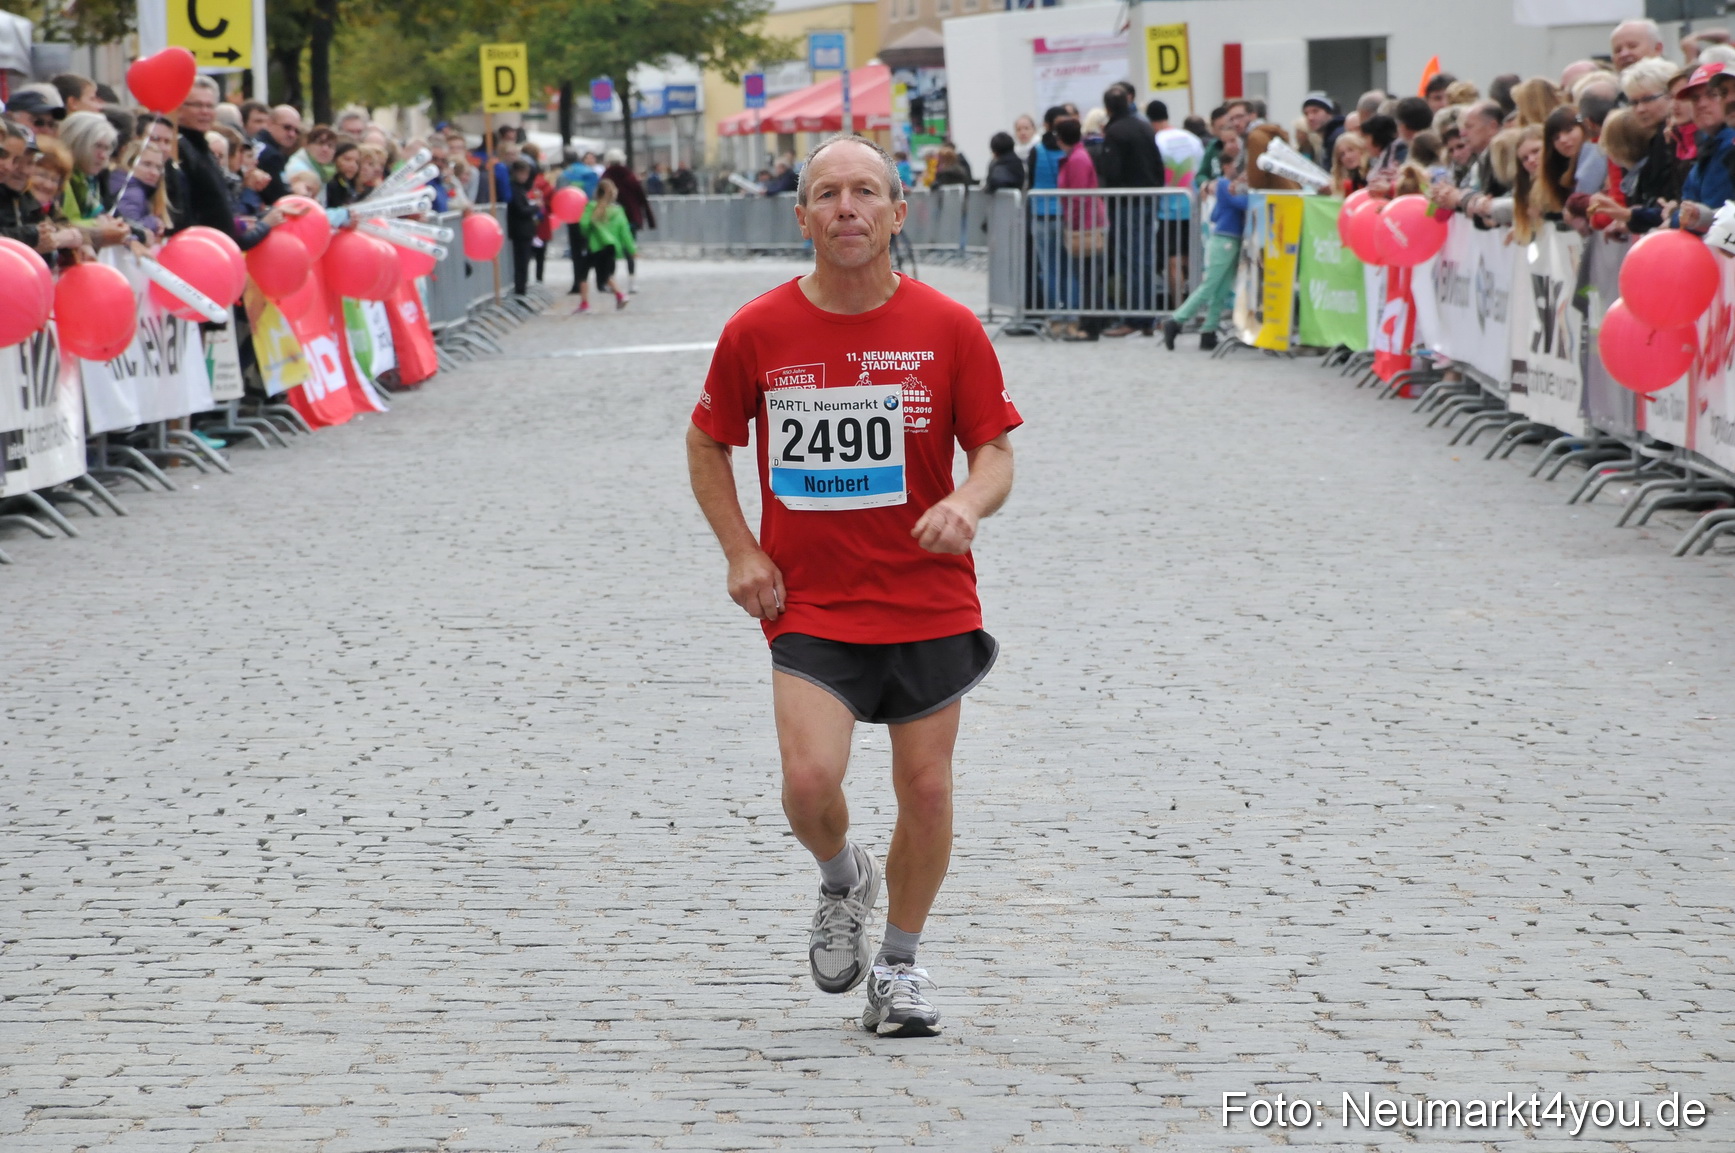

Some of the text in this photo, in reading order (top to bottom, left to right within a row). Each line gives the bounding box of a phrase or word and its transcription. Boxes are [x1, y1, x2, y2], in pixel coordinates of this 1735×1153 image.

[188, 0, 229, 38] C
[1158, 45, 1180, 75] D
[495, 66, 516, 96] D
[846, 351, 935, 362] 11. NEUMARKTER
[861, 361, 921, 371] STADTLAUF
[774, 374, 816, 387] IMMER
[769, 399, 878, 412] PARTL Neumarkt
[903, 406, 933, 414] 09.2010
[782, 416, 892, 463] 2490
[804, 475, 870, 493] Norbert
